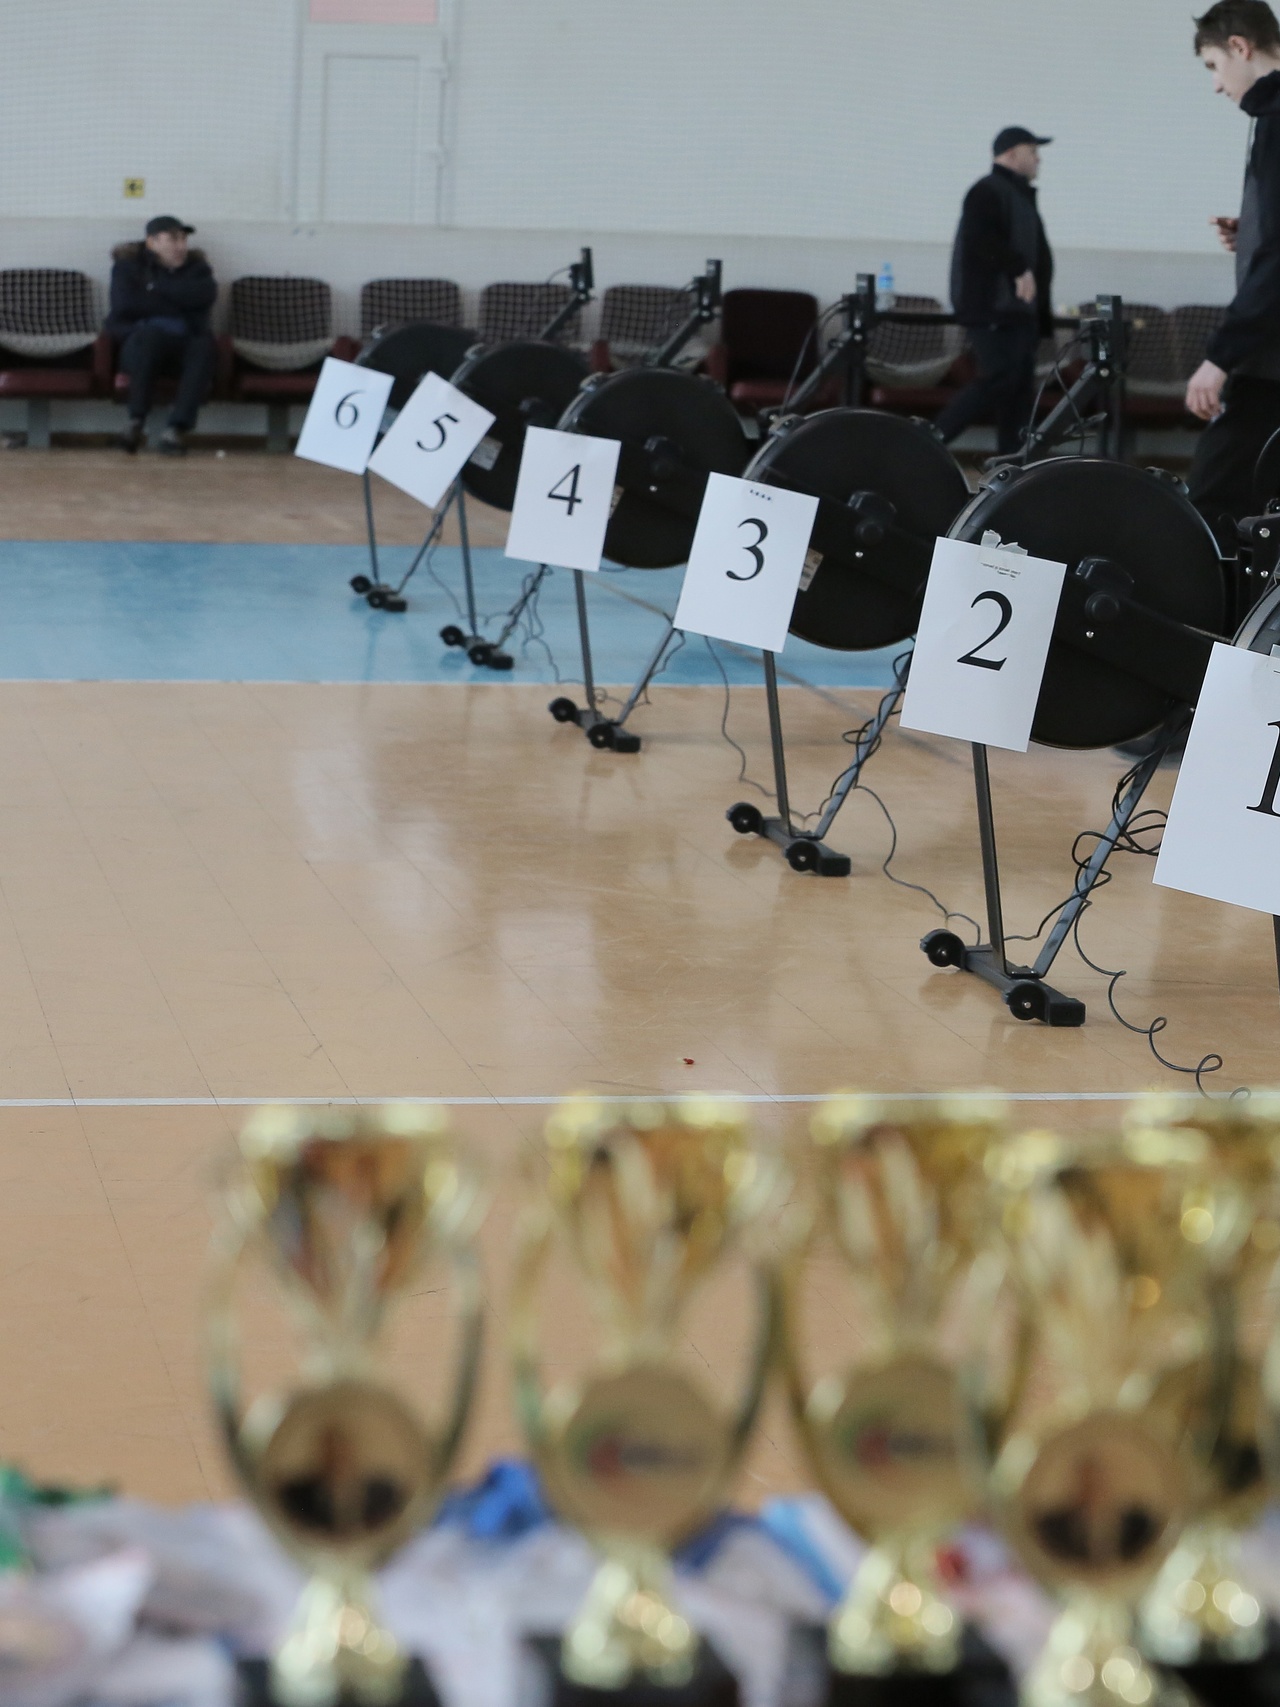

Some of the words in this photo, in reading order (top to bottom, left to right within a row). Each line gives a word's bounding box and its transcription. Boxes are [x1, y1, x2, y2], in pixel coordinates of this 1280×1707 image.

[334, 390, 366, 429] 6
[416, 413, 459, 452] 5
[547, 463, 582, 516] 4
[725, 517, 769, 581] 3
[956, 590, 1013, 672] 2
